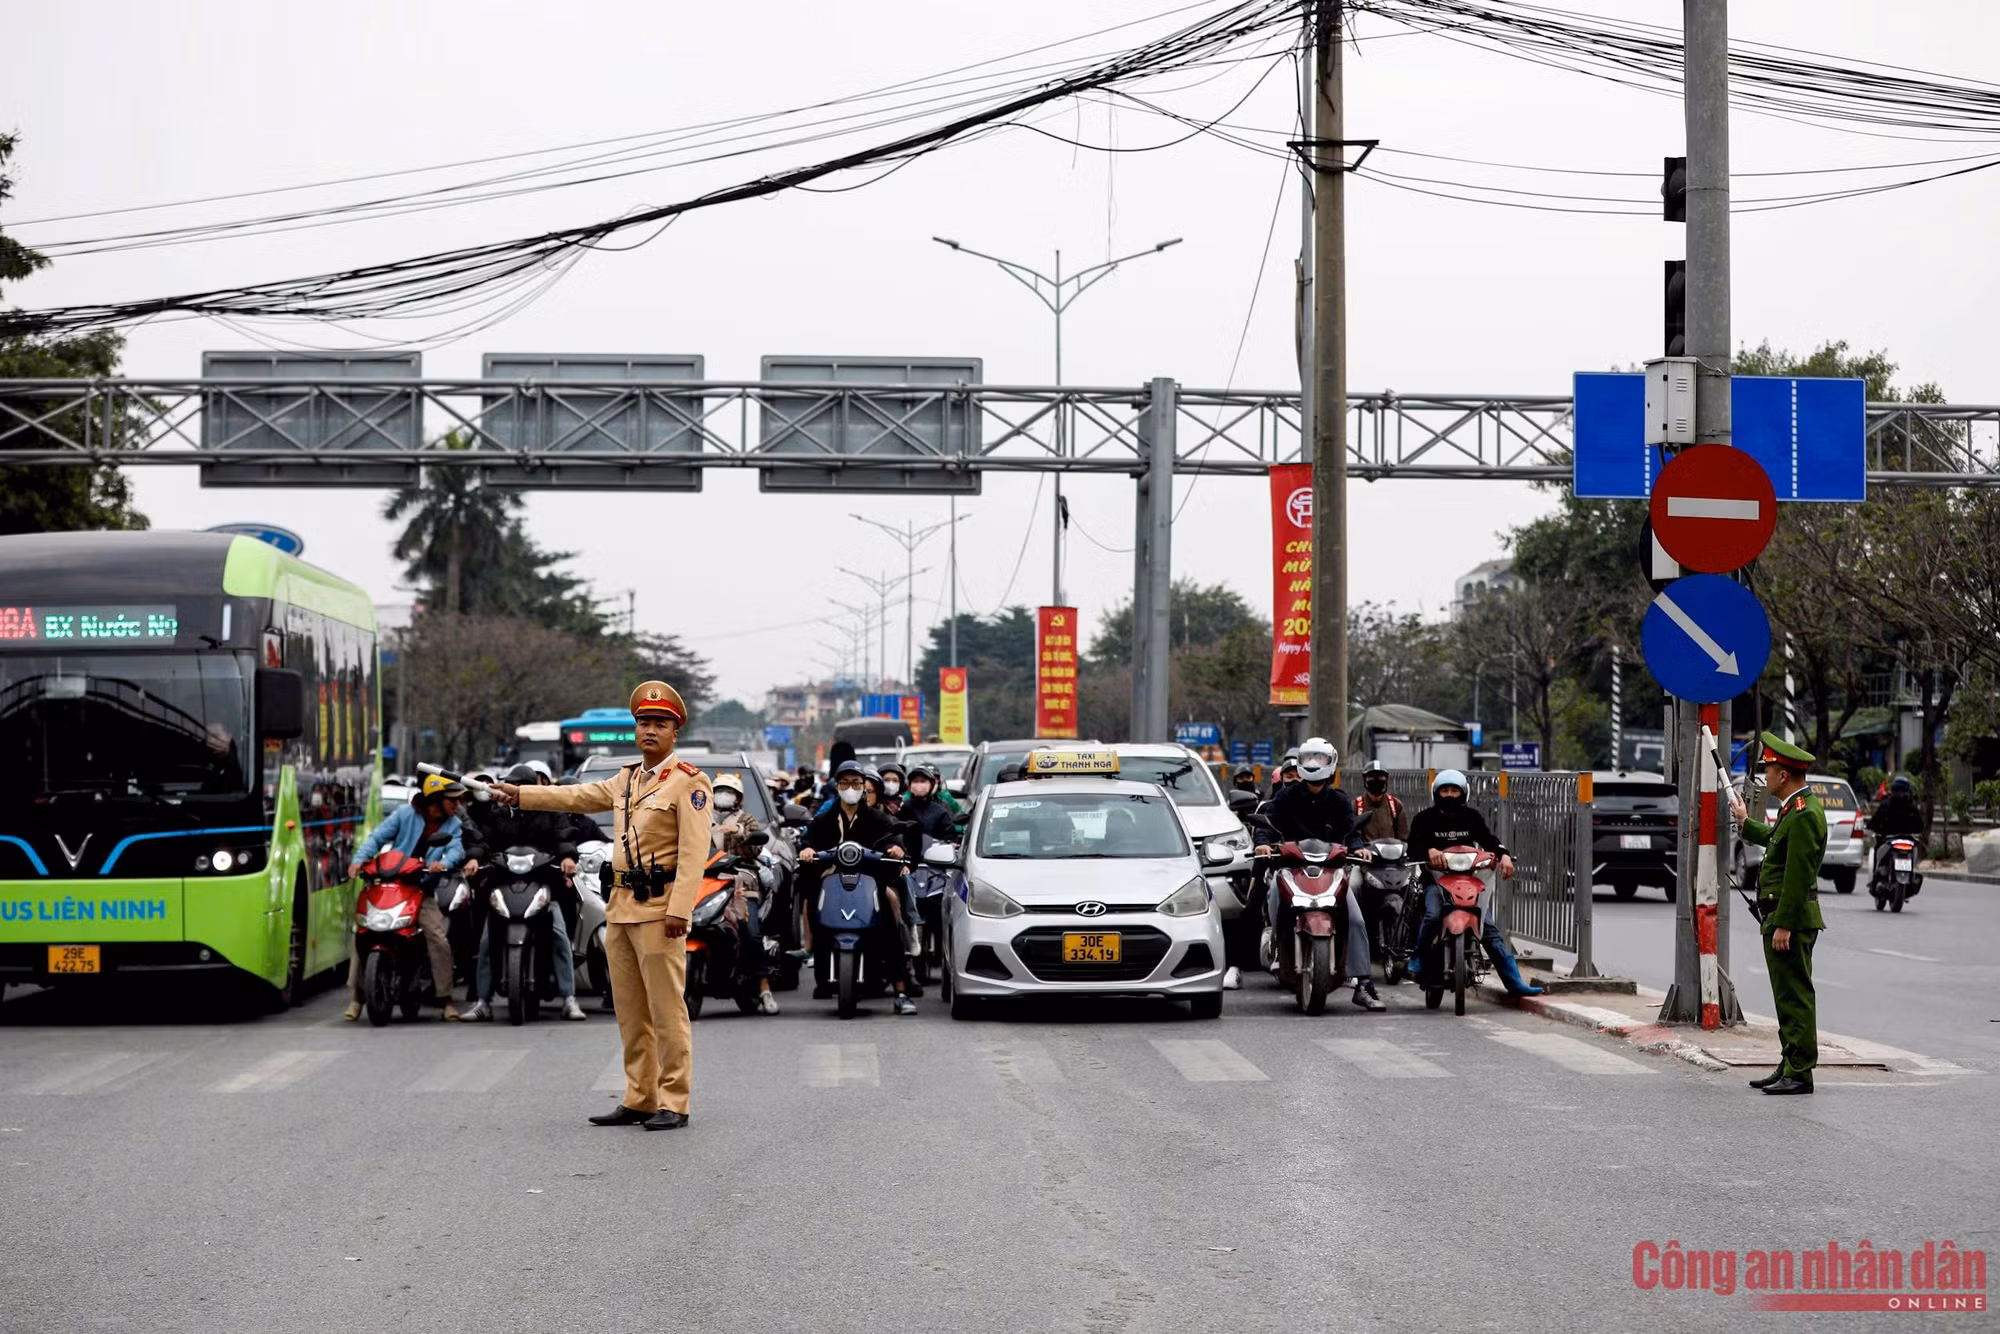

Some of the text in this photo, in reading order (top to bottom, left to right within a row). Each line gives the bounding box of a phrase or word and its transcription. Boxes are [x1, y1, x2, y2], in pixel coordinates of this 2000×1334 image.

[1282, 557, 1312, 573] MỪ
[46, 616, 74, 638] BX
[81, 613, 141, 638] Nước
[39, 896, 95, 921] LIÊN
[101, 900, 166, 921] NINH
[1080, 936, 1104, 947] 30E
[63, 947, 84, 960] 29E
[1070, 949, 1114, 961] 334.19
[54, 960, 95, 972] 422.75
